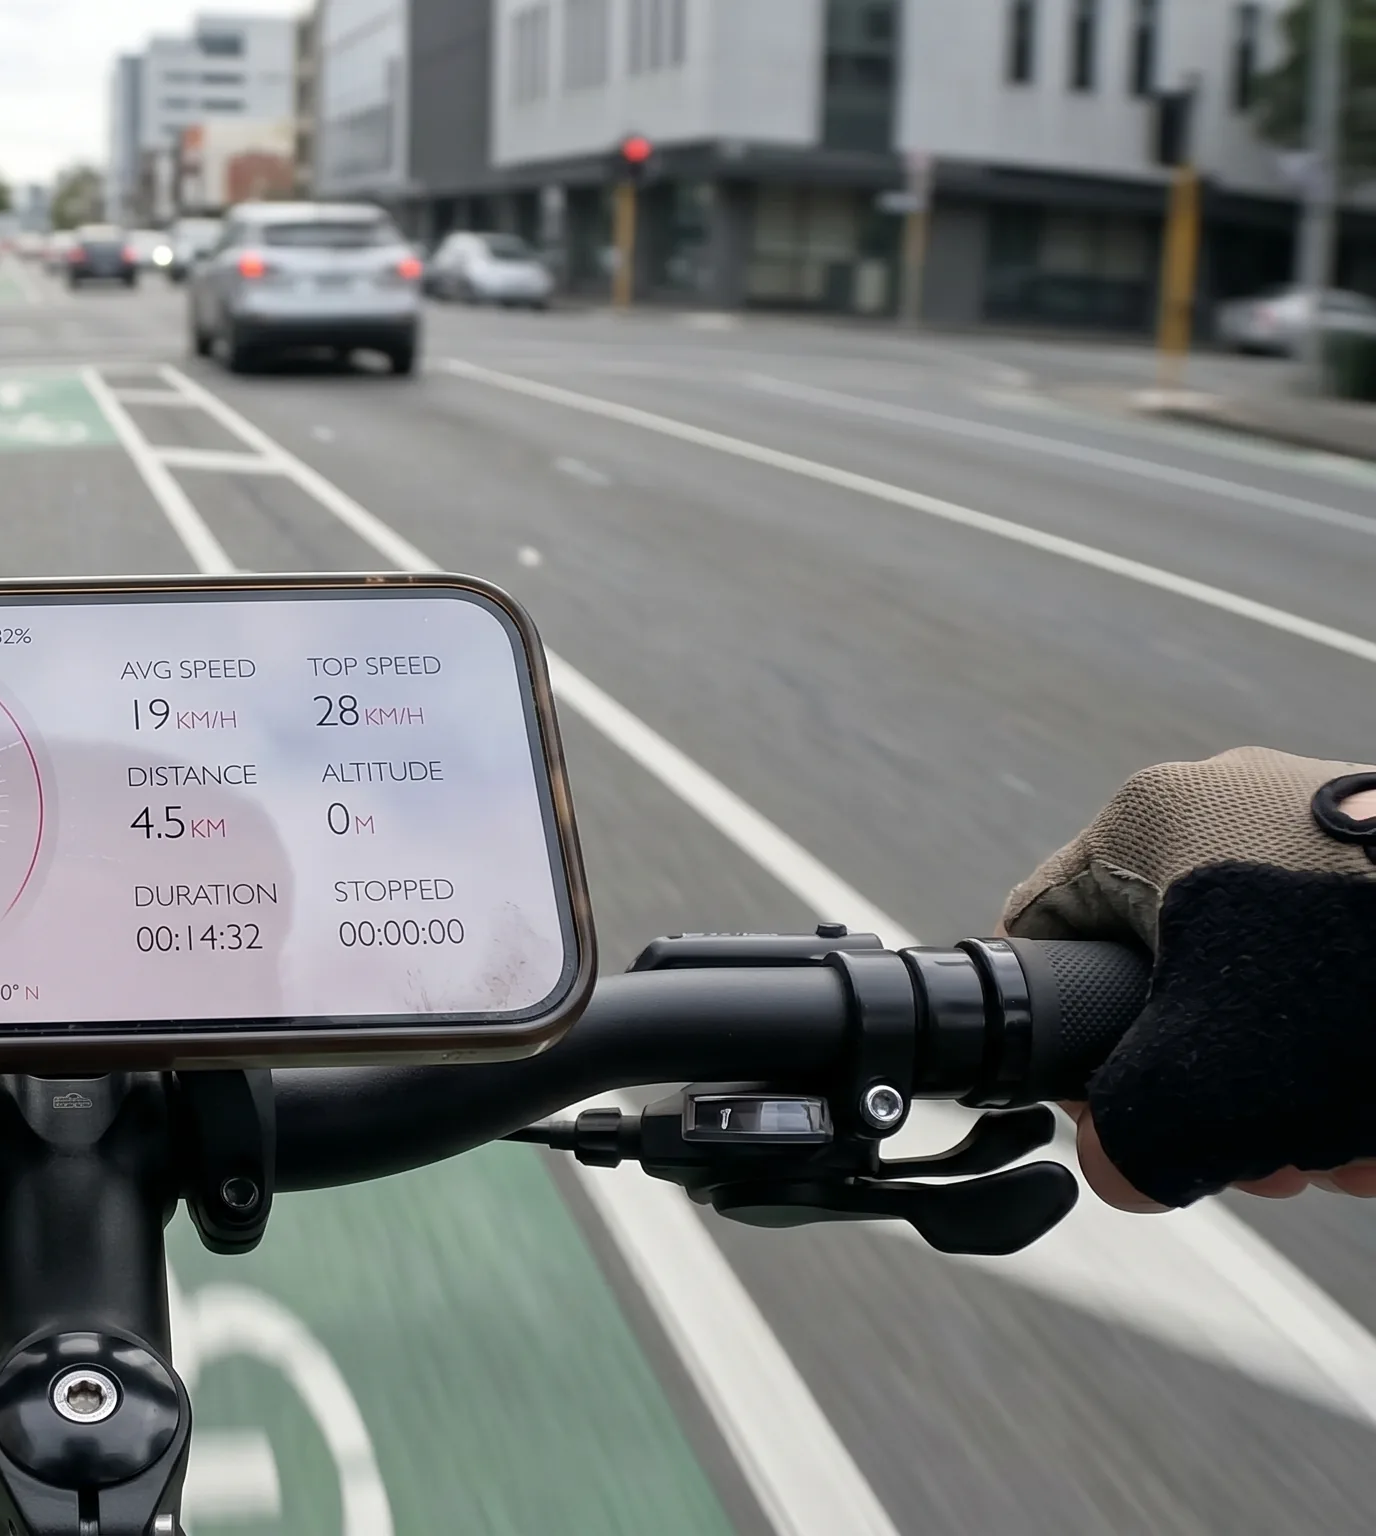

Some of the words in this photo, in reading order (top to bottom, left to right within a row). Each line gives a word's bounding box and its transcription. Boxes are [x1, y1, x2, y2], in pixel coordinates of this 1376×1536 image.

[120, 660, 172, 681] AVG
[179, 659, 256, 680] SPEED
[306, 657, 358, 677] TOP
[365, 655, 441, 676] SPEED
[133, 698, 170, 731] 19
[176, 710, 237, 730] KM/H
[313, 694, 360, 727] 28
[364, 706, 424, 726] KM/H
[127, 764, 258, 787] DISTANCE
[321, 760, 444, 783] ALTITUDE
[129, 805, 186, 840] 4.5
[190, 818, 226, 839] KM
[327, 802, 350, 836] 0
[354, 815, 375, 835] M
[134, 882, 278, 907] DURATION
[334, 878, 455, 903] STOPPED
[136, 923, 264, 953] 00:14:32
[338, 918, 465, 948] 00:00:00
[0, 983, 20, 1001] 0°
[25, 985, 39, 1001] N
